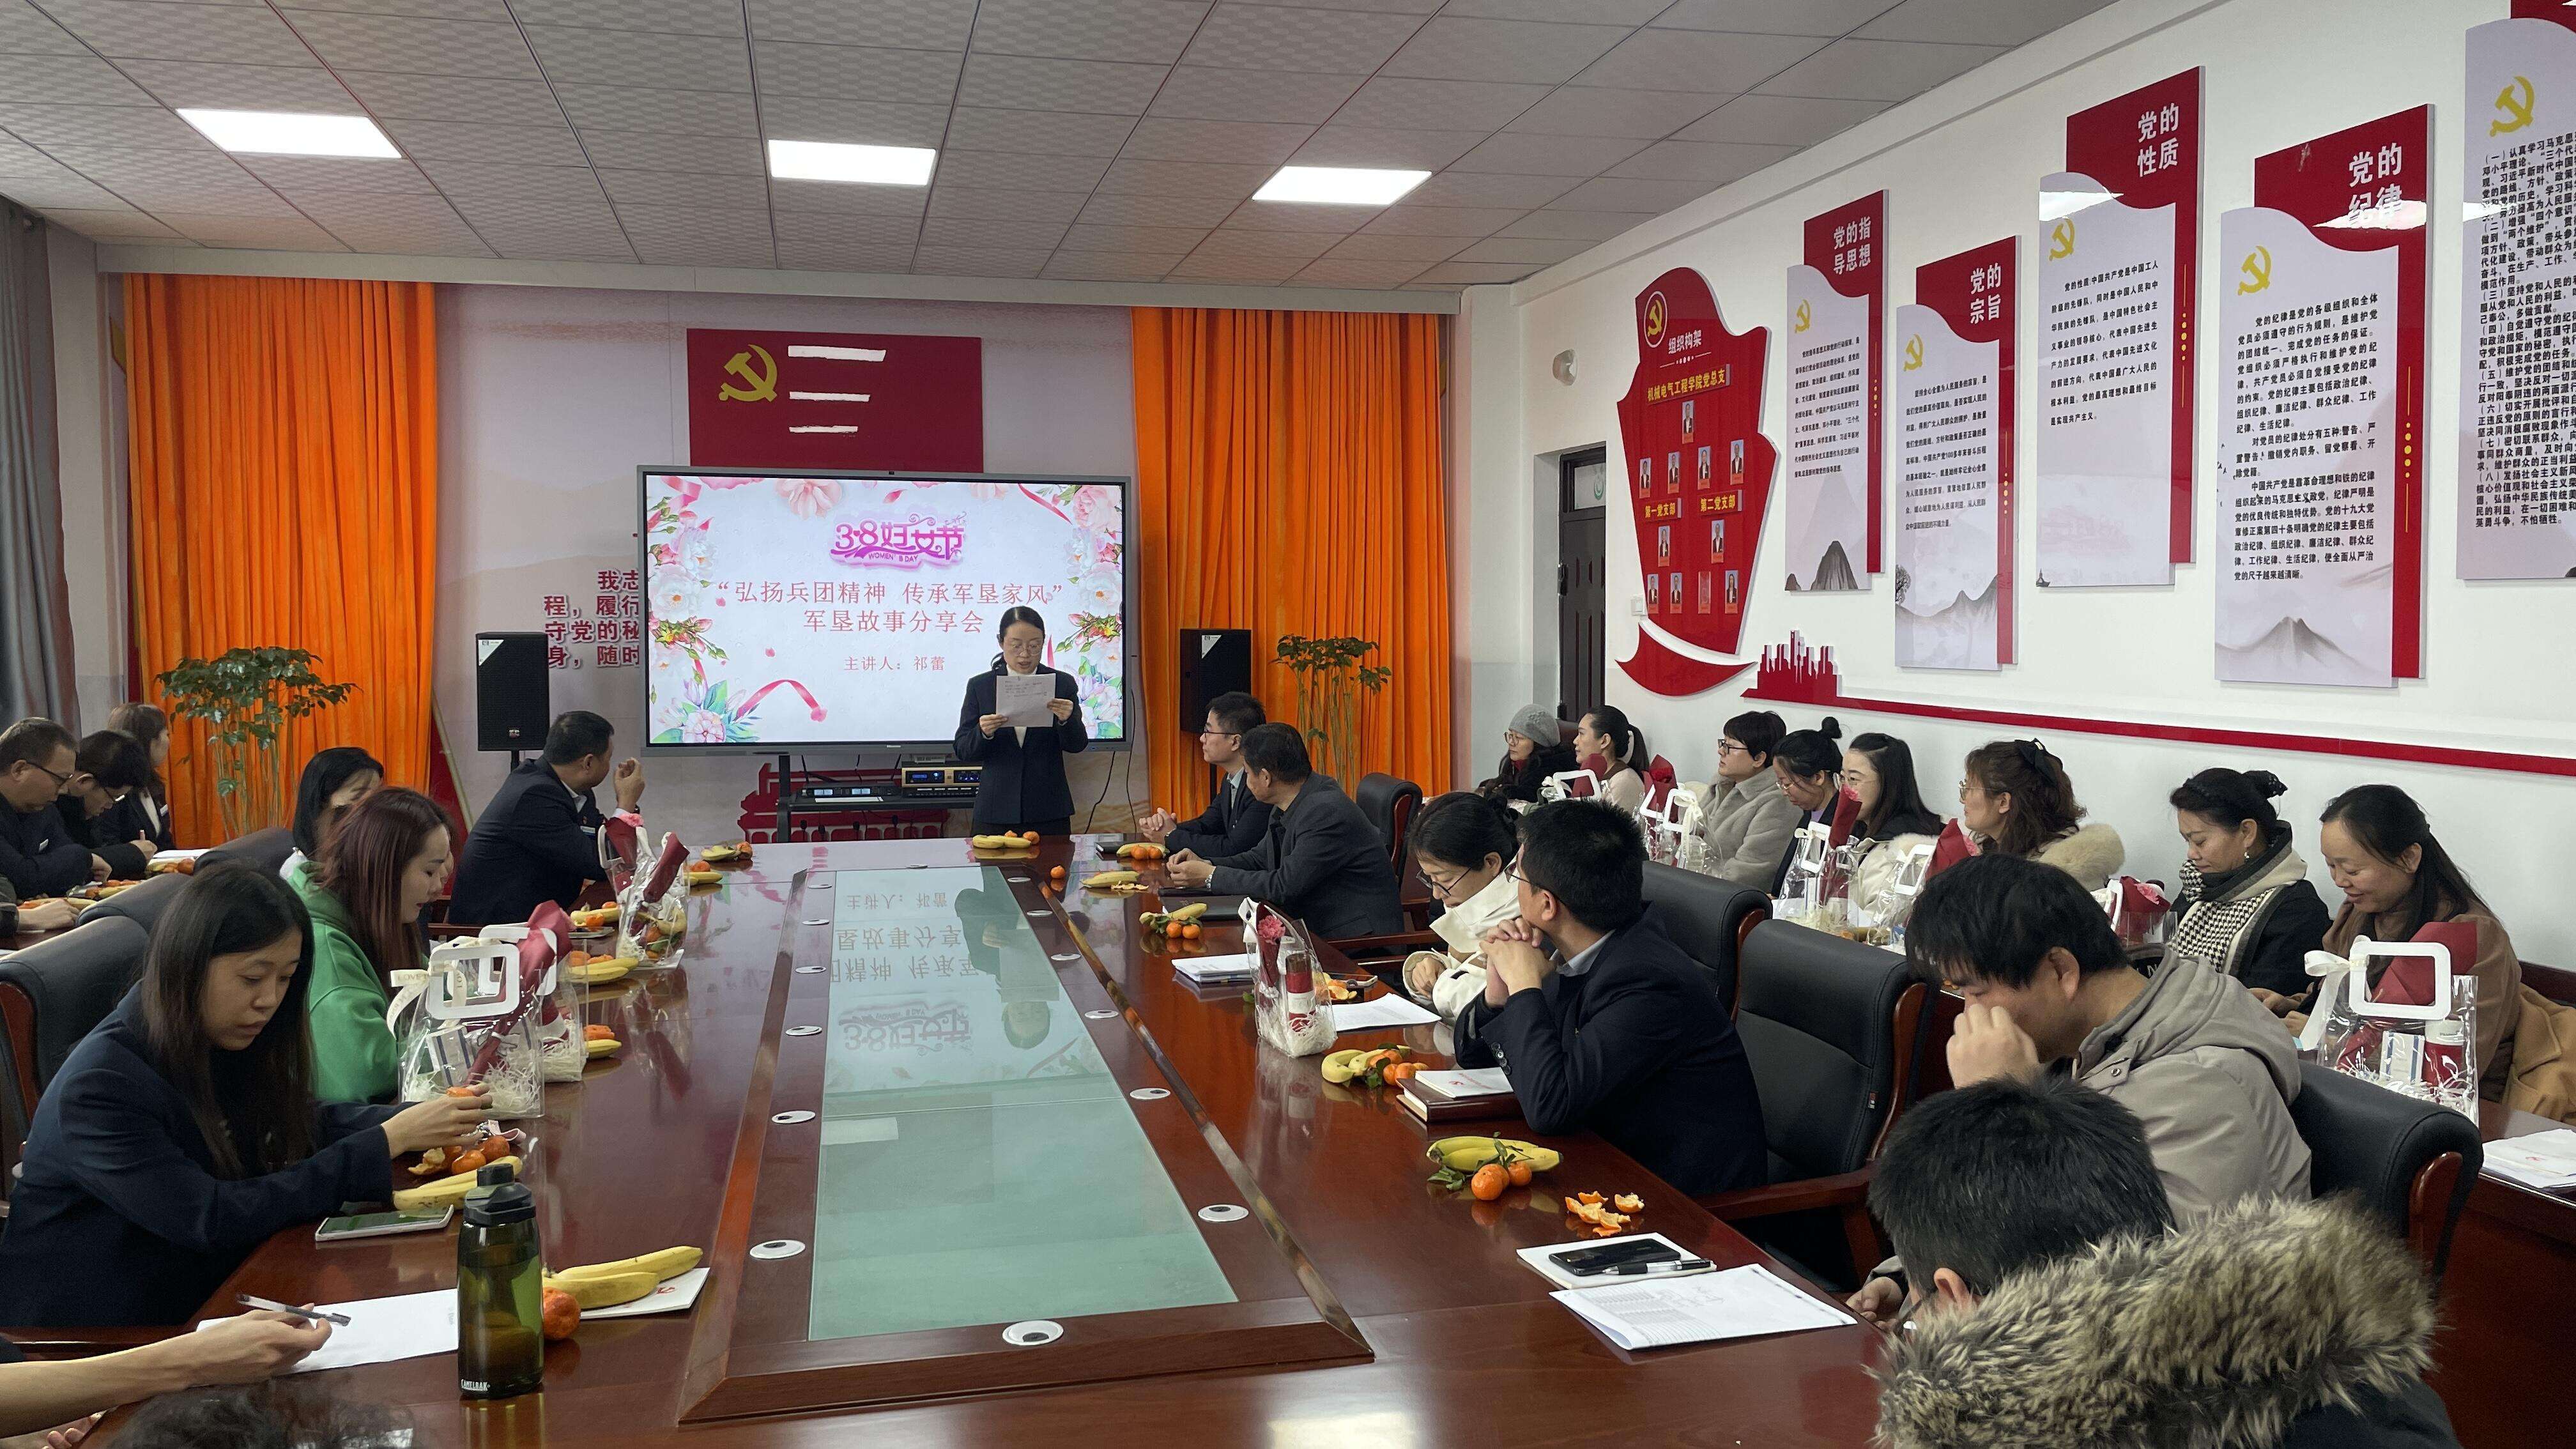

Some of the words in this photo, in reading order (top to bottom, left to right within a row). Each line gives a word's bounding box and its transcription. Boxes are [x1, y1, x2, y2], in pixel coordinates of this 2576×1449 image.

[2137, 103, 2179, 142] 党的
[2137, 137, 2179, 177] 性质
[2349, 142, 2402, 188] 党的
[2482, 155, 2576, 187] 观、习近平新时代中国
[2482, 167, 2576, 199] 党的路线、方针、政策
[1834, 216, 1871, 249] 党的指
[1834, 243, 1871, 275] 导思想
[1970, 263, 2001, 295] 党的
[2481, 275, 2520, 290] 模范作用。
[1970, 294, 2001, 324] 宗旨
[2255, 293, 2378, 327] 党的纪律是党的各级组织和全体
[1668, 330, 1702, 355] 组织构架
[2237, 309, 2378, 345] 党员必须遵守的行为规则，是维护党
[2237, 342, 2377, 375] 党组织必须严格执行和维护党的纪
[2237, 358, 2377, 389] 律，共产党员必须自觉接受党的纪律
[1647, 369, 1726, 402] 机械电气工程学院党总支
[2236, 418, 2294, 433] 纪律、生活纪律。
[2251, 470, 2375, 491] 中国共产党是靠革命理想和铁的纪律
[1644, 502, 1676, 519] 第一党支部
[1699, 494, 1736, 512] 第二党支部
[2235, 503, 2374, 522] 党的优良传统和独特优势。党的十九大党
[2235, 519, 2374, 537] 章修正案第四十条明确党的纪律主要包括
[2234, 569, 2303, 581] 党的尺子越来越清晰。
[717, 580, 886, 605] “弘扬兵团精神
[902, 583, 1062, 605] 传承军垦家风”
[802, 609, 984, 634] 军垦故事分享会
